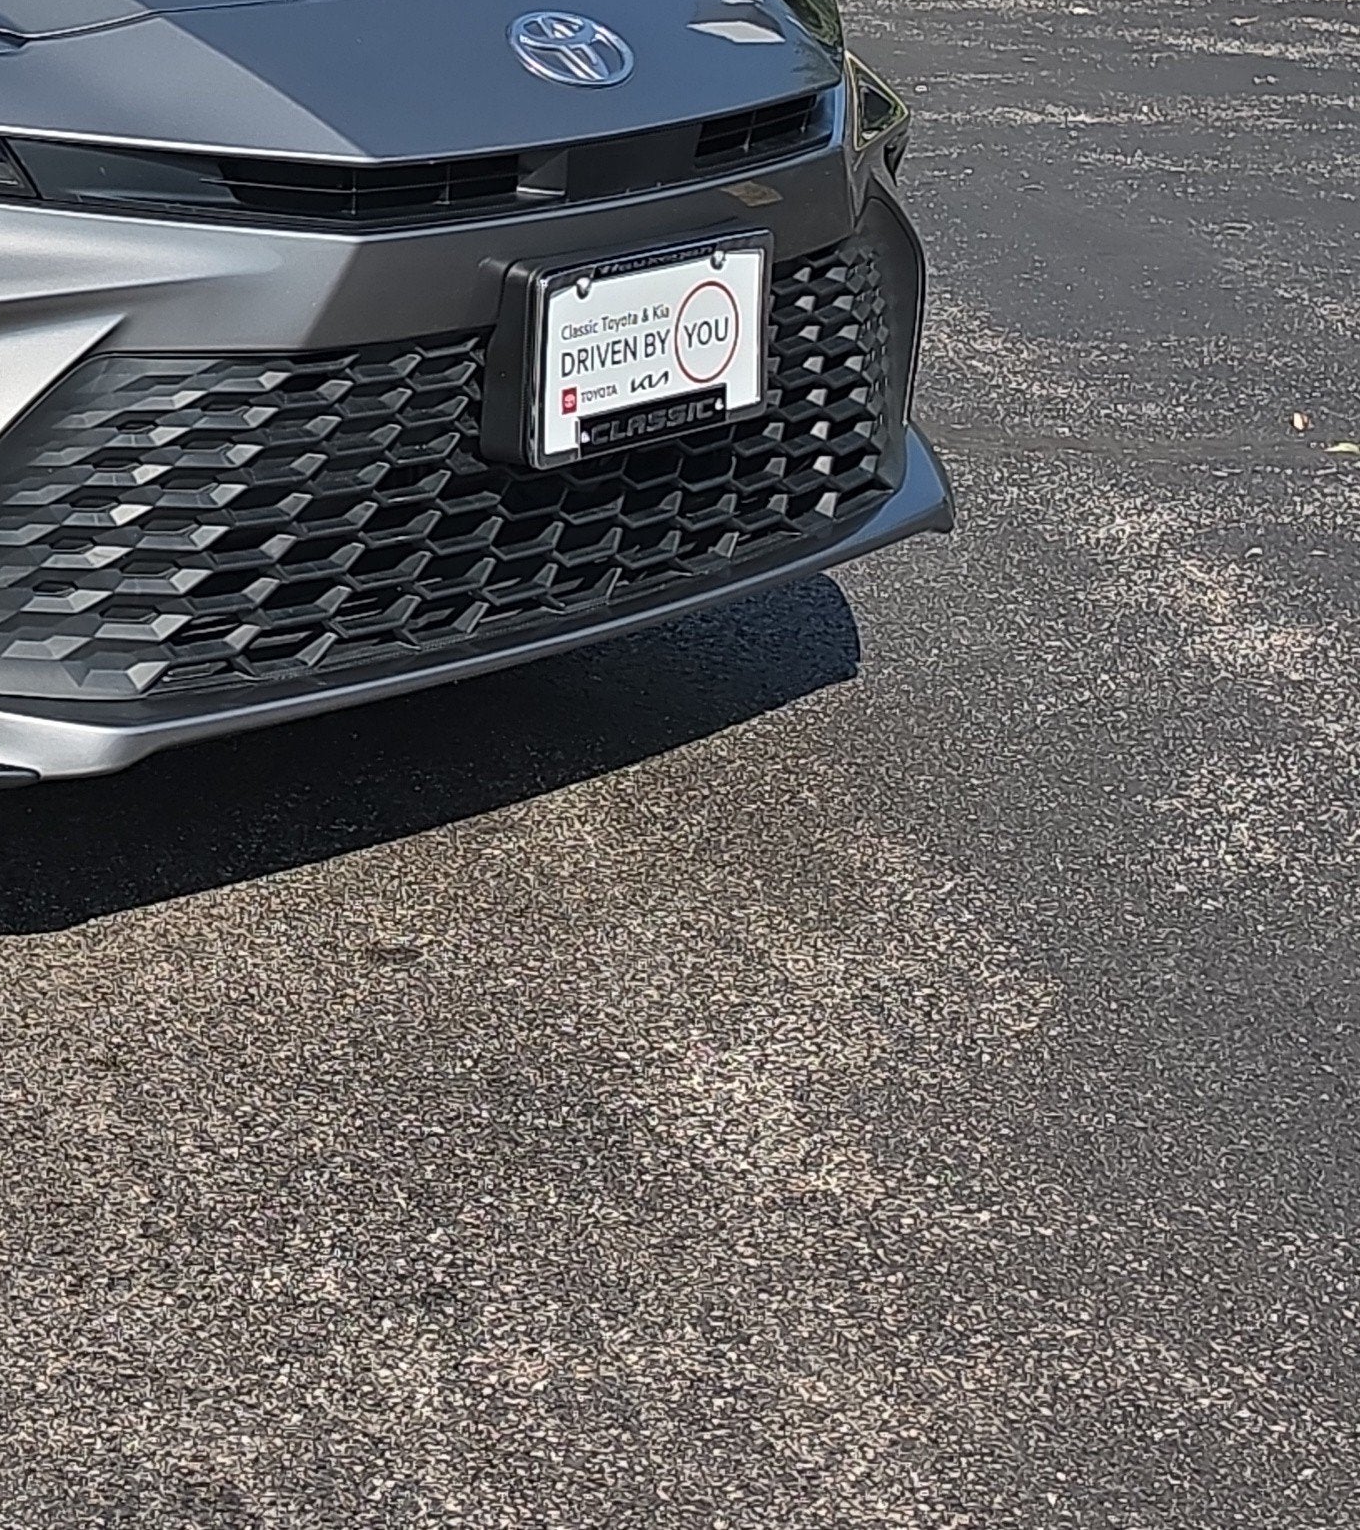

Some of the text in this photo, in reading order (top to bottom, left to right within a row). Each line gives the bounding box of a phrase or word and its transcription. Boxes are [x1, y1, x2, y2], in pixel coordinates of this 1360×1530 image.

[561, 304, 669, 340] Classic Toyota & Kia
[561, 317, 729, 378] DRIVEN BY YOU
[581, 384, 618, 402] TOYOTA
[590, 398, 717, 446] CLASSIC
